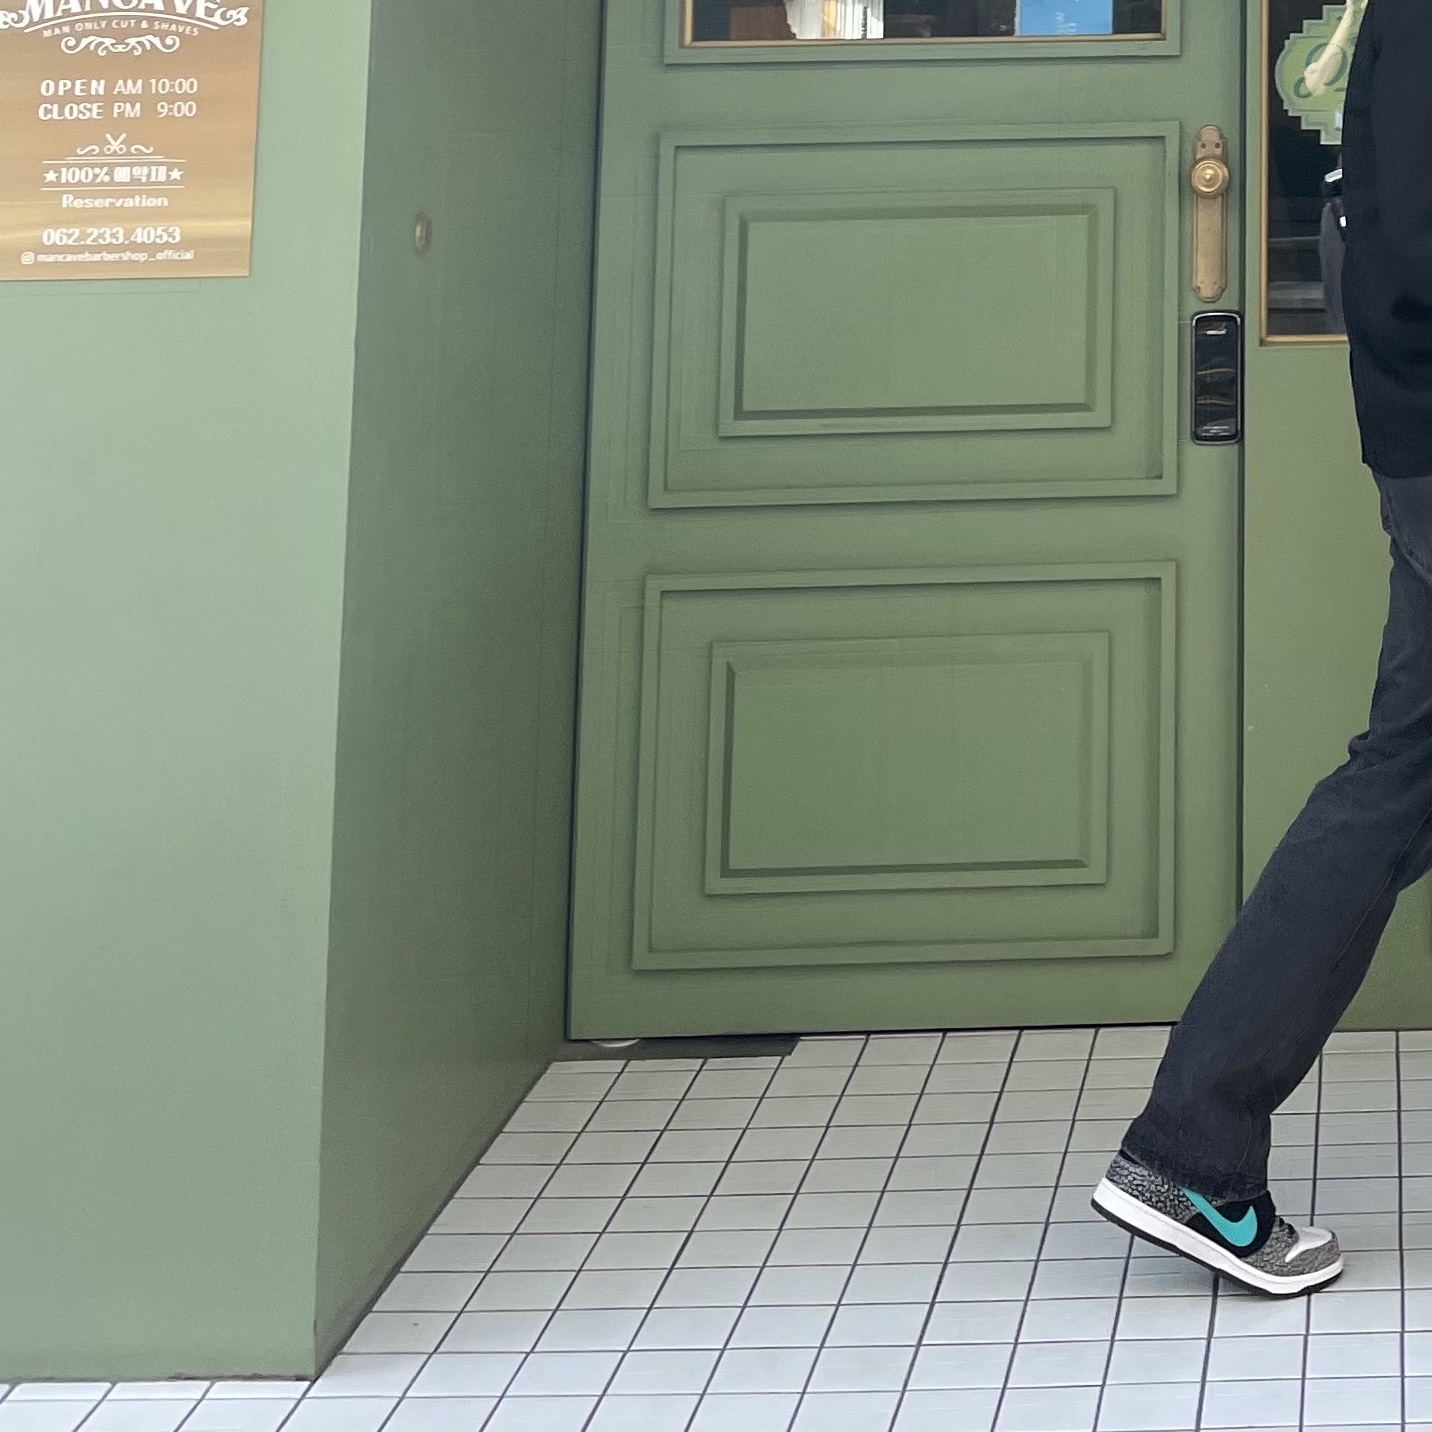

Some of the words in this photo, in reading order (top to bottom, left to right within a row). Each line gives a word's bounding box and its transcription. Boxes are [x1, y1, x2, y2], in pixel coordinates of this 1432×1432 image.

[43, 25, 71, 38] MAN
[75, 20, 107, 32] ONLY
[112, 19, 136, 30] CUT
[140, 20, 149, 30] &
[153, 20, 200, 37] SHAVES
[40, 79, 105, 97] OPEN
[113, 78, 143, 95] AM
[149, 78, 198, 95] 10:00
[38, 102, 105, 120] CLOSE
[113, 102, 141, 118] PM
[156, 101, 197, 118] 9:00
[60, 166, 111, 184] 100%
[61, 194, 169, 209] Reservation
[42, 226, 182, 246] 062.233.4053
